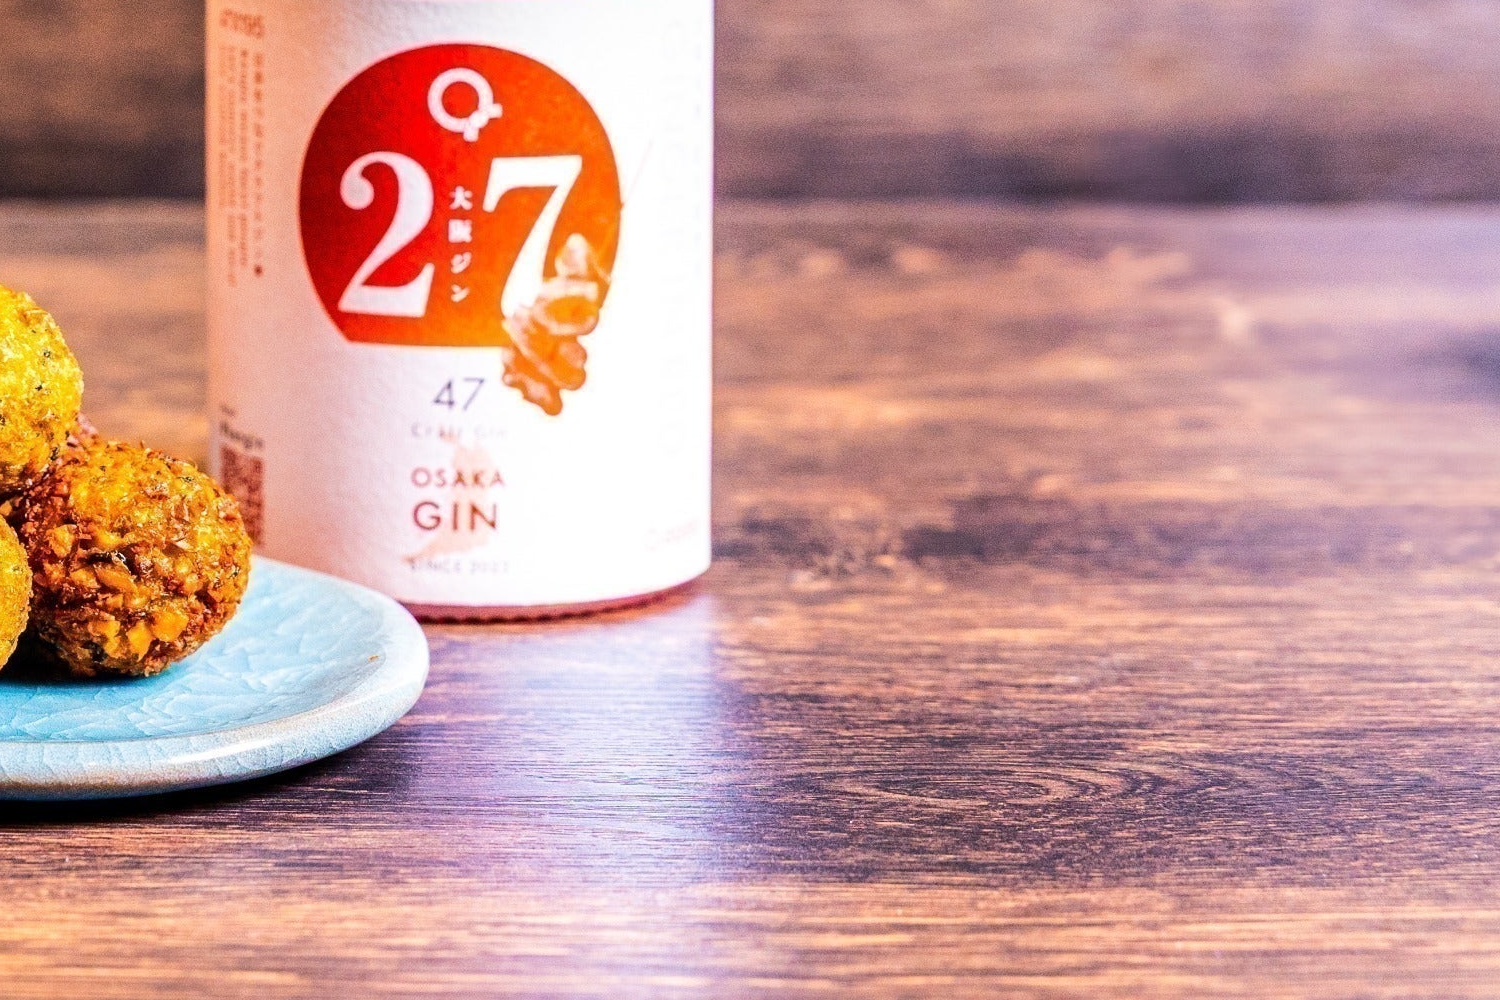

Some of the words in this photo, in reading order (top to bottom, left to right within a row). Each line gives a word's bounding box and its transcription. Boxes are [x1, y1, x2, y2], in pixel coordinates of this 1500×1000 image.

[338, 151, 583, 318] 27
[449, 185, 473, 303] 大阪ジン
[432, 377, 485, 411] 47
[411, 467, 506, 489] OSAKA
[413, 500, 497, 532] GIN
